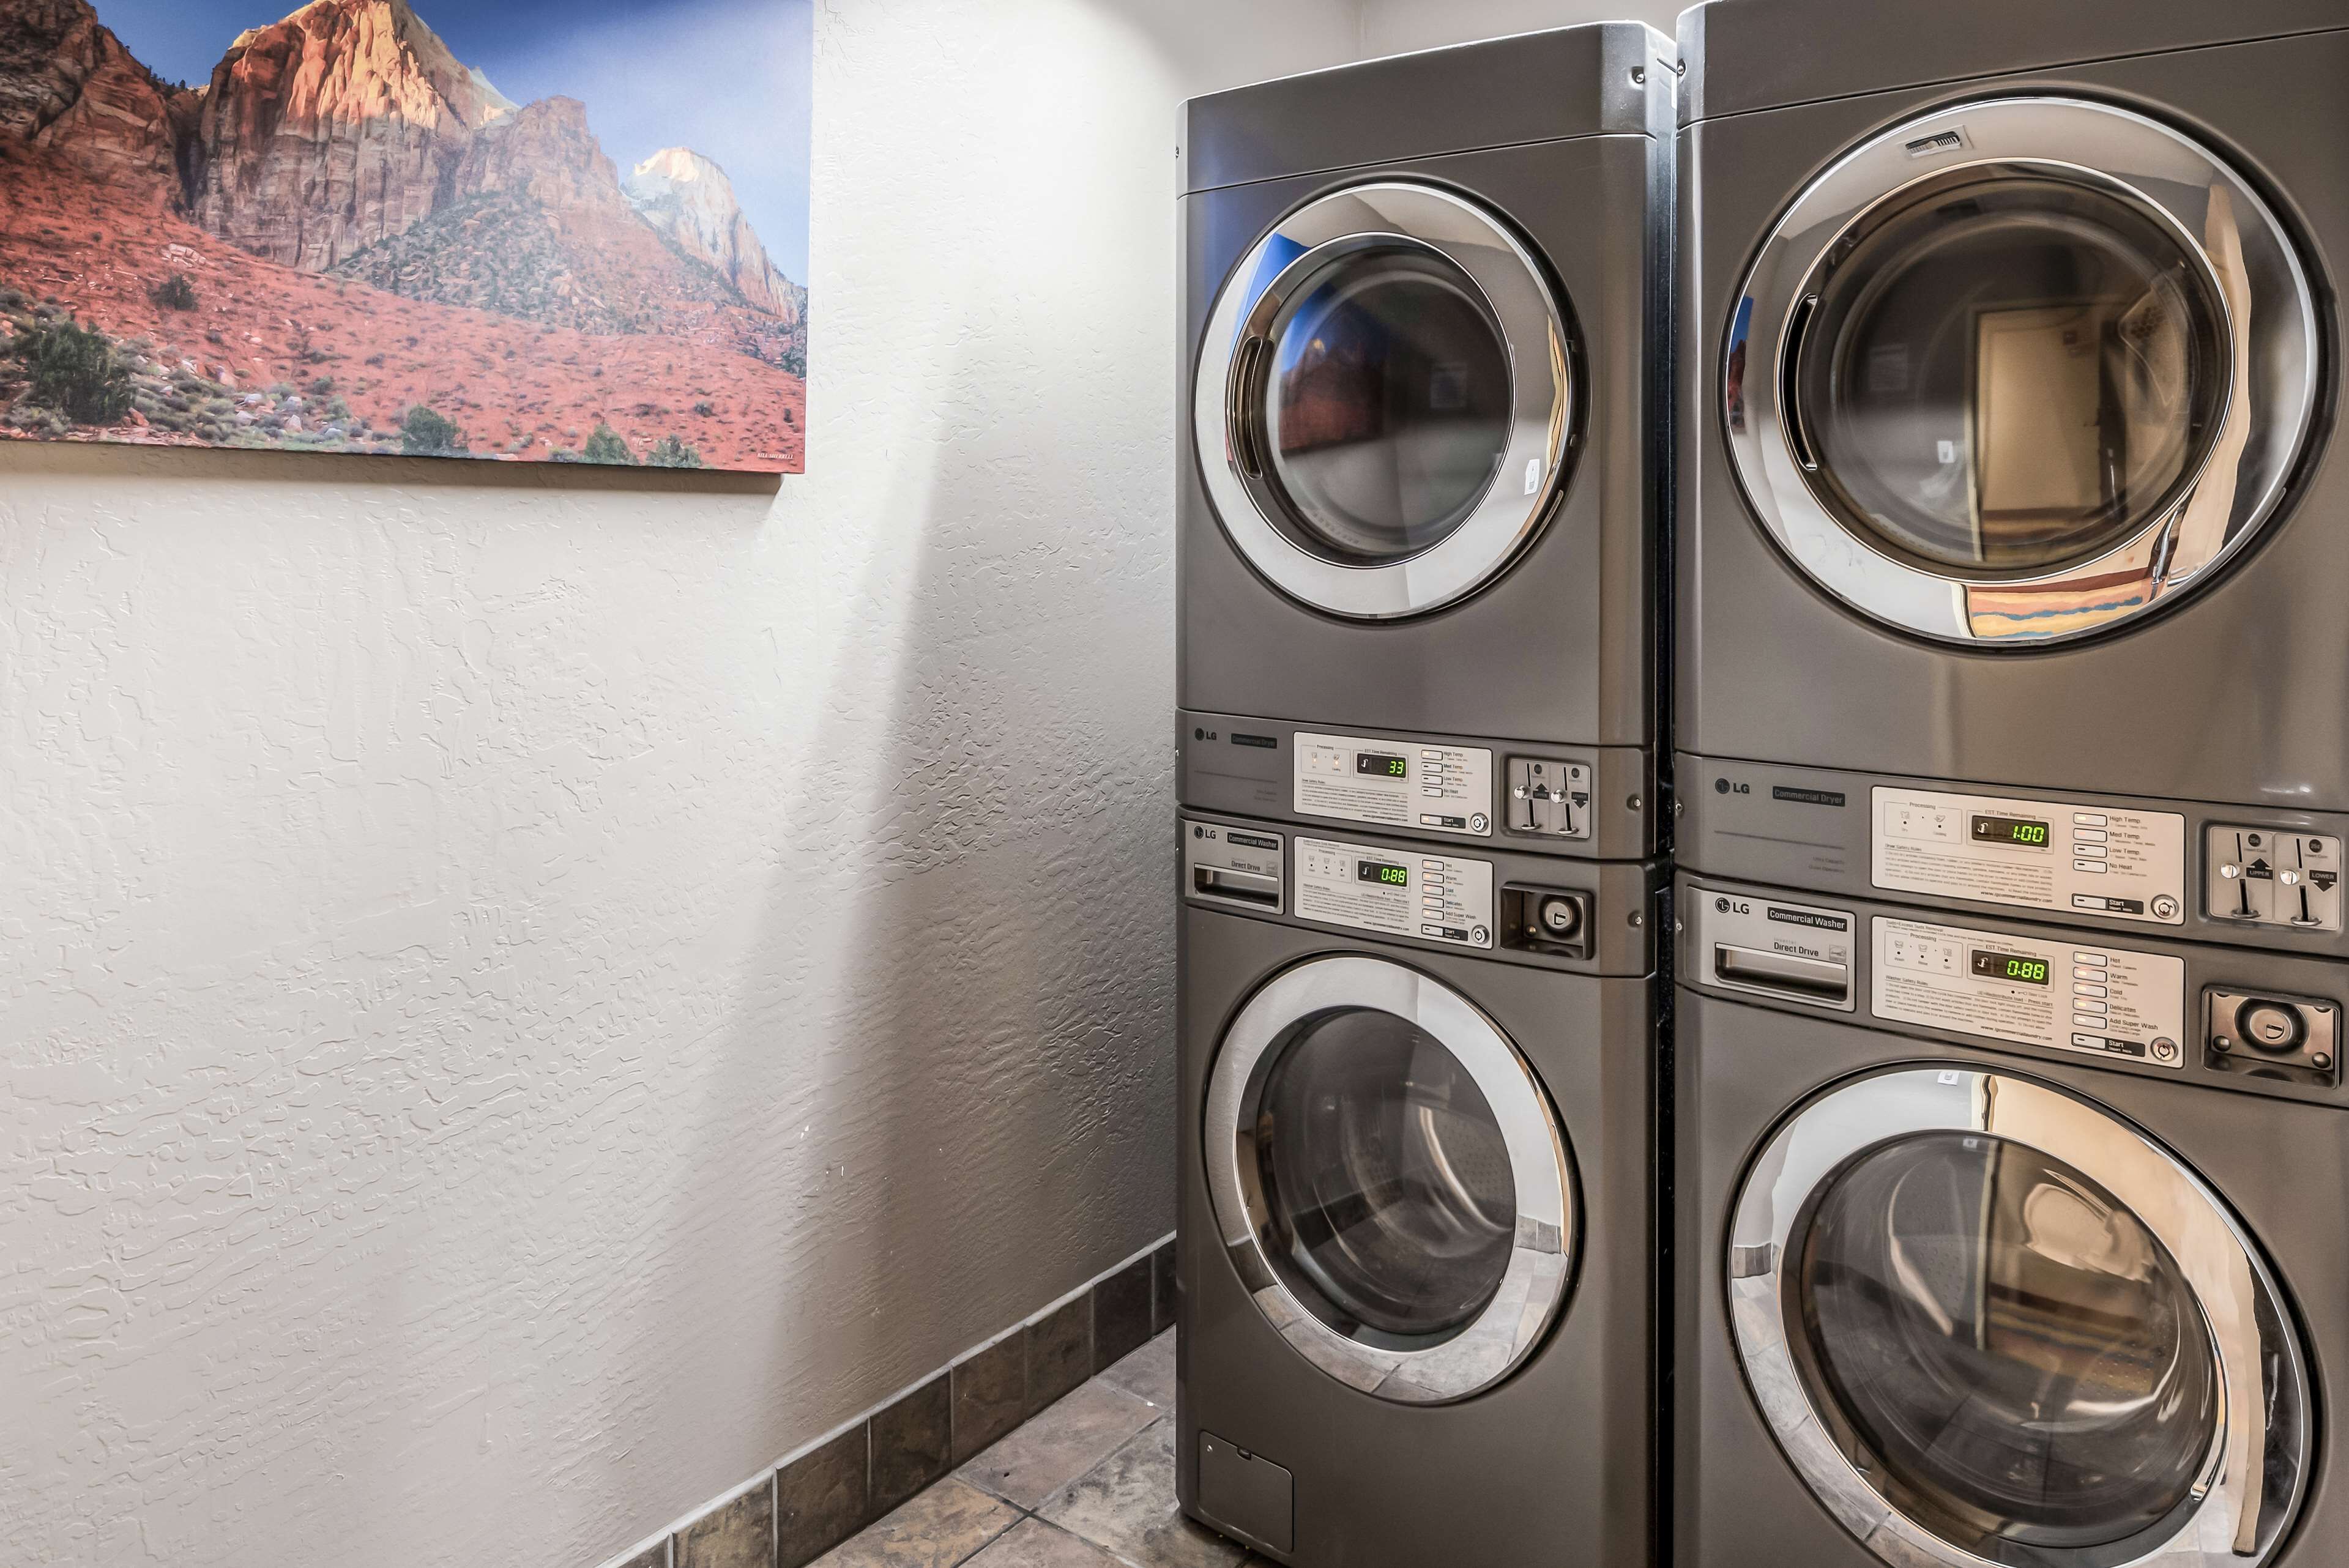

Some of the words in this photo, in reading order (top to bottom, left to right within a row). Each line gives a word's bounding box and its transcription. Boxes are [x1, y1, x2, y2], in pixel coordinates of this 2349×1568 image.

[1206, 732, 1217, 740] LG
[1390, 761, 1404, 774] 33
[1733, 783, 1750, 794] LG
[1774, 789, 1819, 801] Commercial
[1820, 794, 1843, 804] Dryer
[2009, 811, 2036, 820] Remaining
[1205, 829, 1216, 839] LG
[2012, 825, 2045, 842] 1.00
[1229, 834, 1257, 845] Commercial
[1257, 839, 1277, 849] Washer
[1232, 860, 1246, 869] Direct
[1248, 863, 1260, 872] Drive
[1381, 868, 1405, 883] 0.88
[1733, 902, 1749, 914] LG
[1770, 910, 1813, 924] Commercial
[1815, 917, 1845, 929] Washer
[1910, 933, 1937, 942] Processing
[1774, 943, 1796, 953] Direct
[1799, 946, 1819, 956] Drive
[2009, 947, 2037, 957] Remaining
[2007, 960, 2045, 979] 0.88
[2110, 1004, 2136, 1013] Delicates
